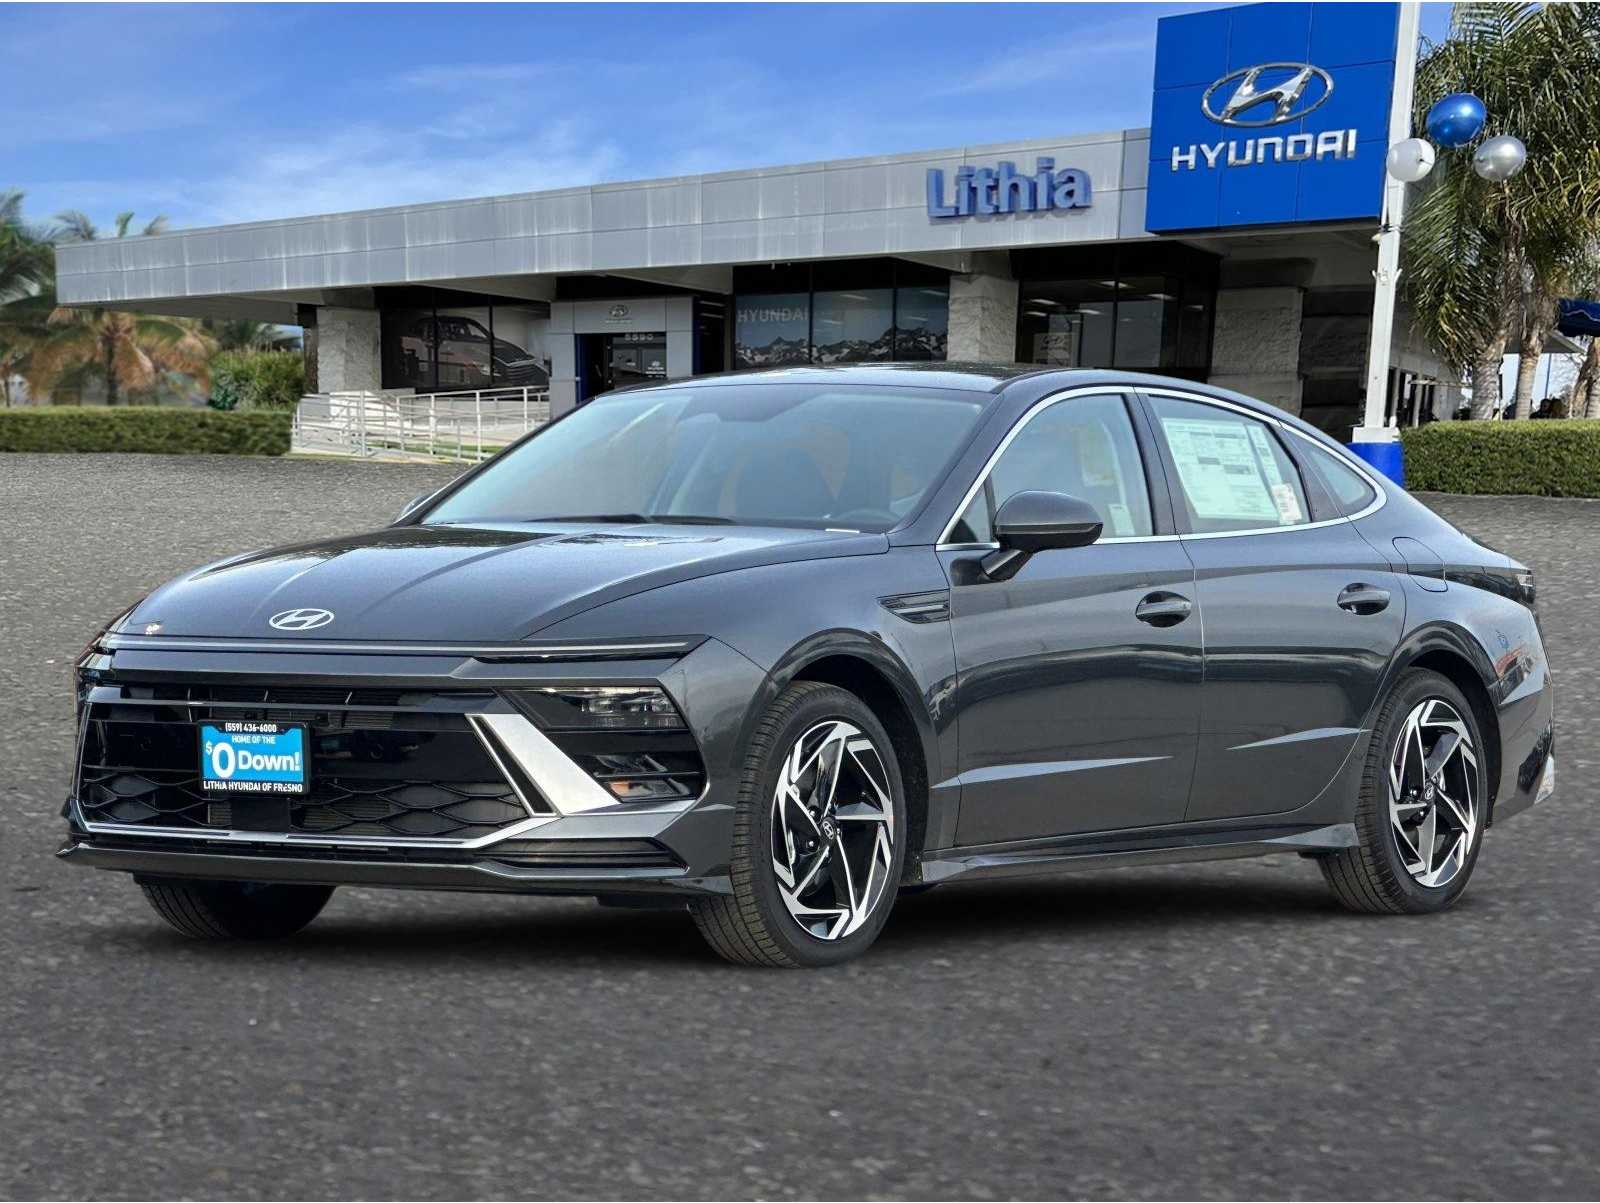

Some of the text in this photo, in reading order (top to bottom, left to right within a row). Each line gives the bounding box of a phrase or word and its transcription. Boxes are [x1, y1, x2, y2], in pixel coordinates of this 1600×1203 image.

[1171, 128, 1357, 172] HYUNDAI
[927, 156, 1092, 217] Lithia
[737, 307, 809, 322] HYUNDAI
[225, 723, 277, 733] (559) 436-6000
[231, 735, 276, 744] HOME OF THE
[238, 750, 301, 771] Down!
[228, 781, 261, 791] HYUNDAI
[262, 782, 272, 792] OF
